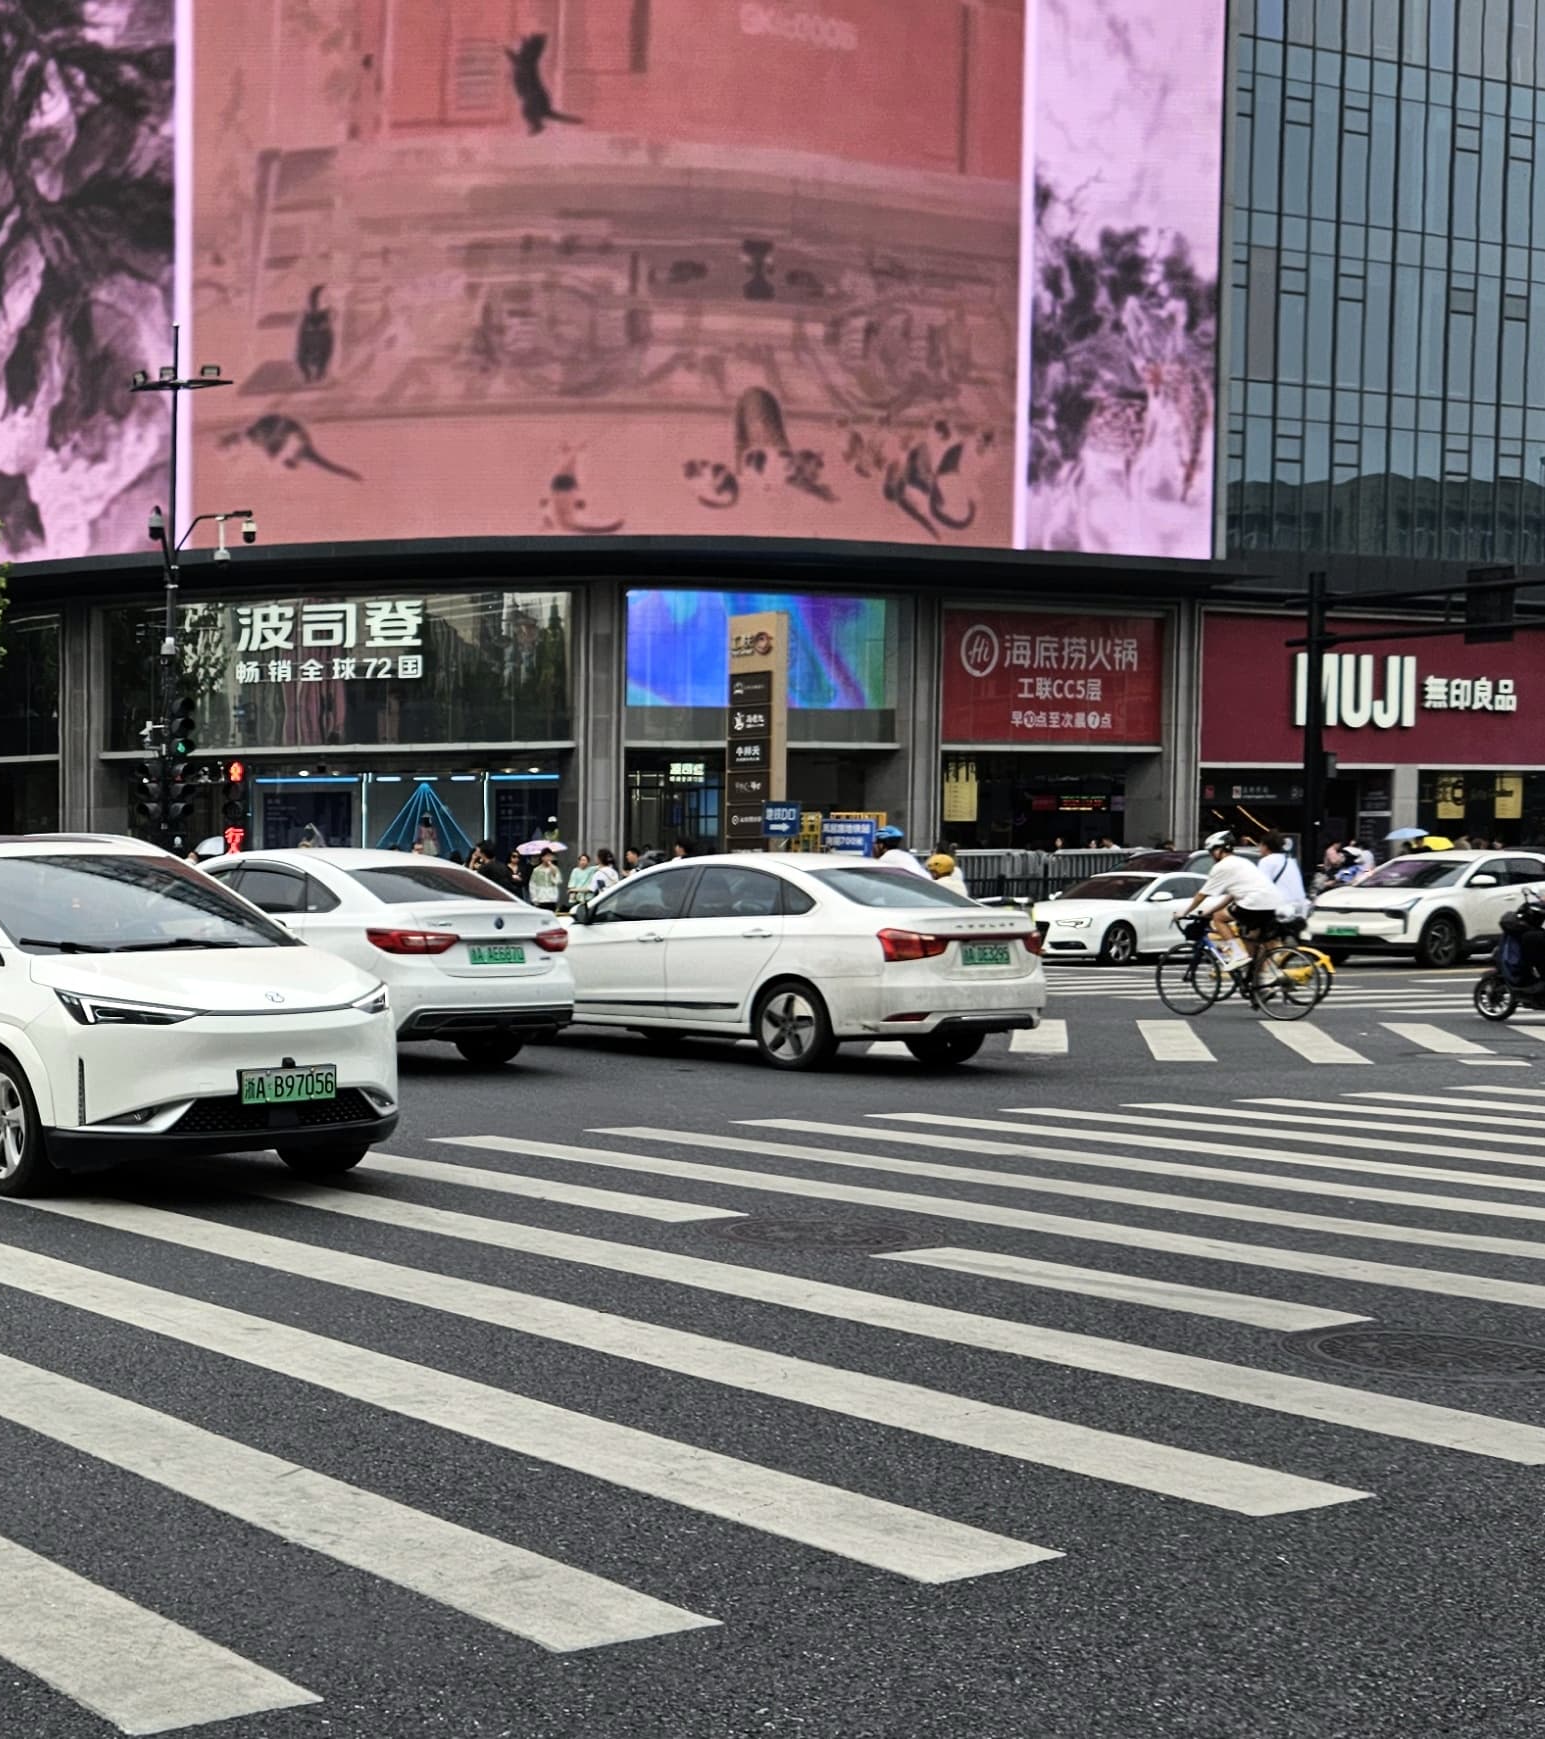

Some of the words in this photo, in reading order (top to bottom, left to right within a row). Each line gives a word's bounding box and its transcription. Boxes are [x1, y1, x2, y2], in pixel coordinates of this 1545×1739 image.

[236, 601, 423, 652] 波司登
[235, 655, 423, 684] 畅销全球72国
[1004, 634, 1138, 672] 海底捞火锅
[1017, 677, 1102, 701] 工联CC5层
[1295, 653, 1417, 728] MUJI
[1423, 675, 1517, 711] 無印良品
